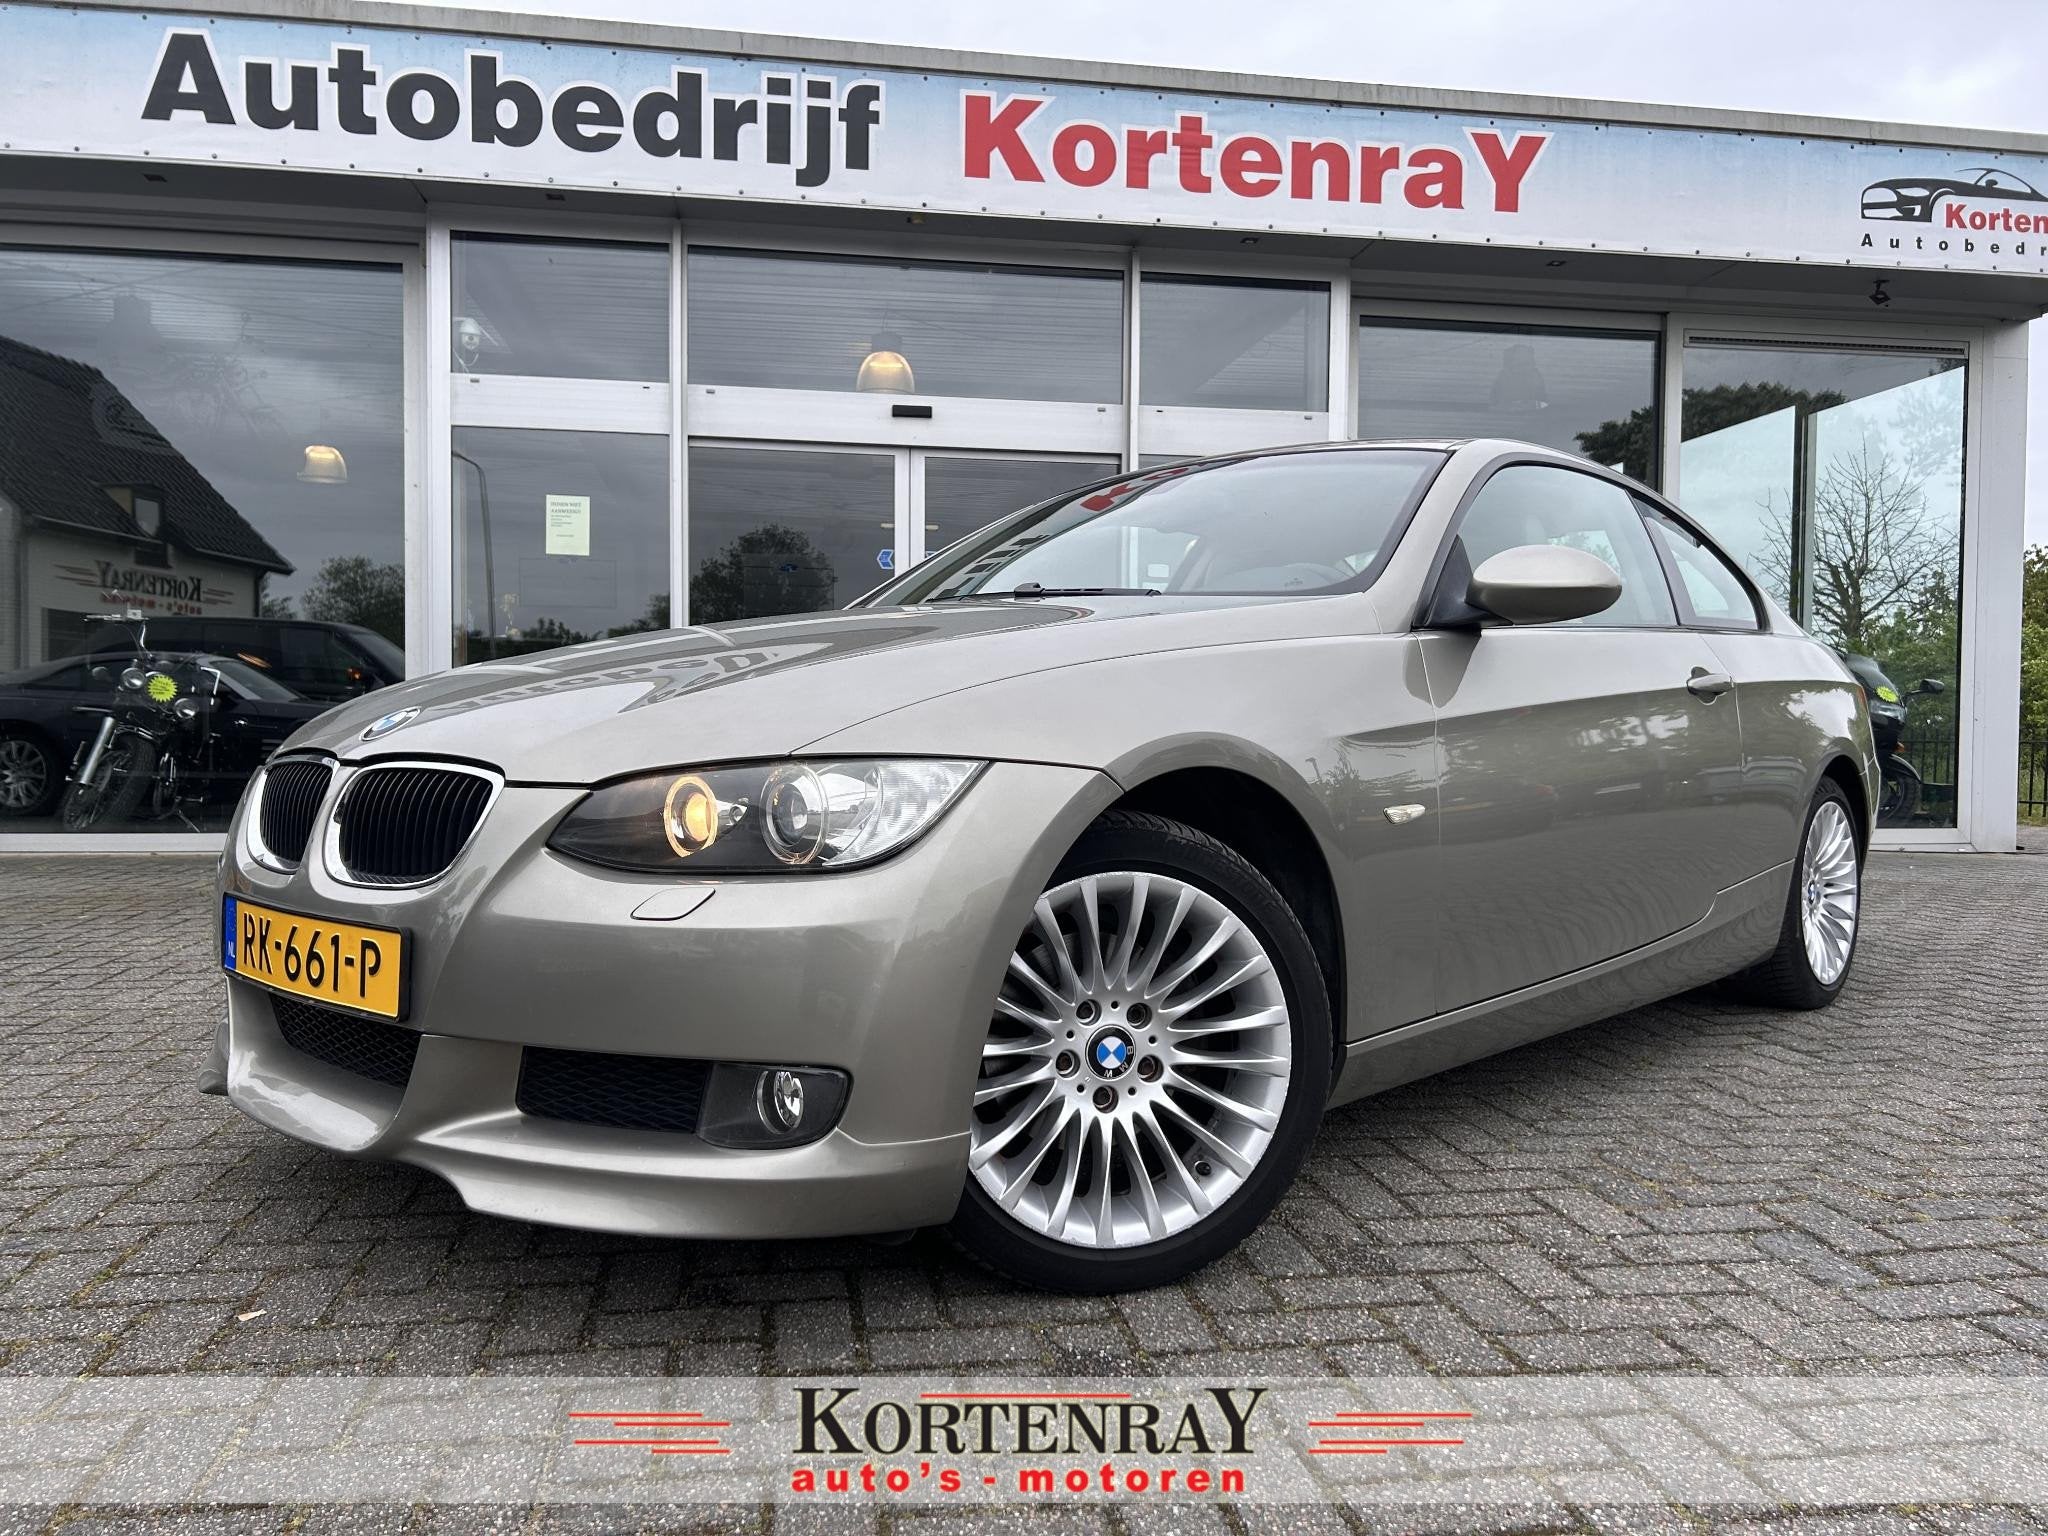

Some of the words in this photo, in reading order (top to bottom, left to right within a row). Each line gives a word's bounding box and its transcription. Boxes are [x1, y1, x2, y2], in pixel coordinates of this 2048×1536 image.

[140, 32, 882, 188] Autobedrijf
[962, 92, 1547, 214] KortenraY
[243, 912, 381, 998] RK-661-P
